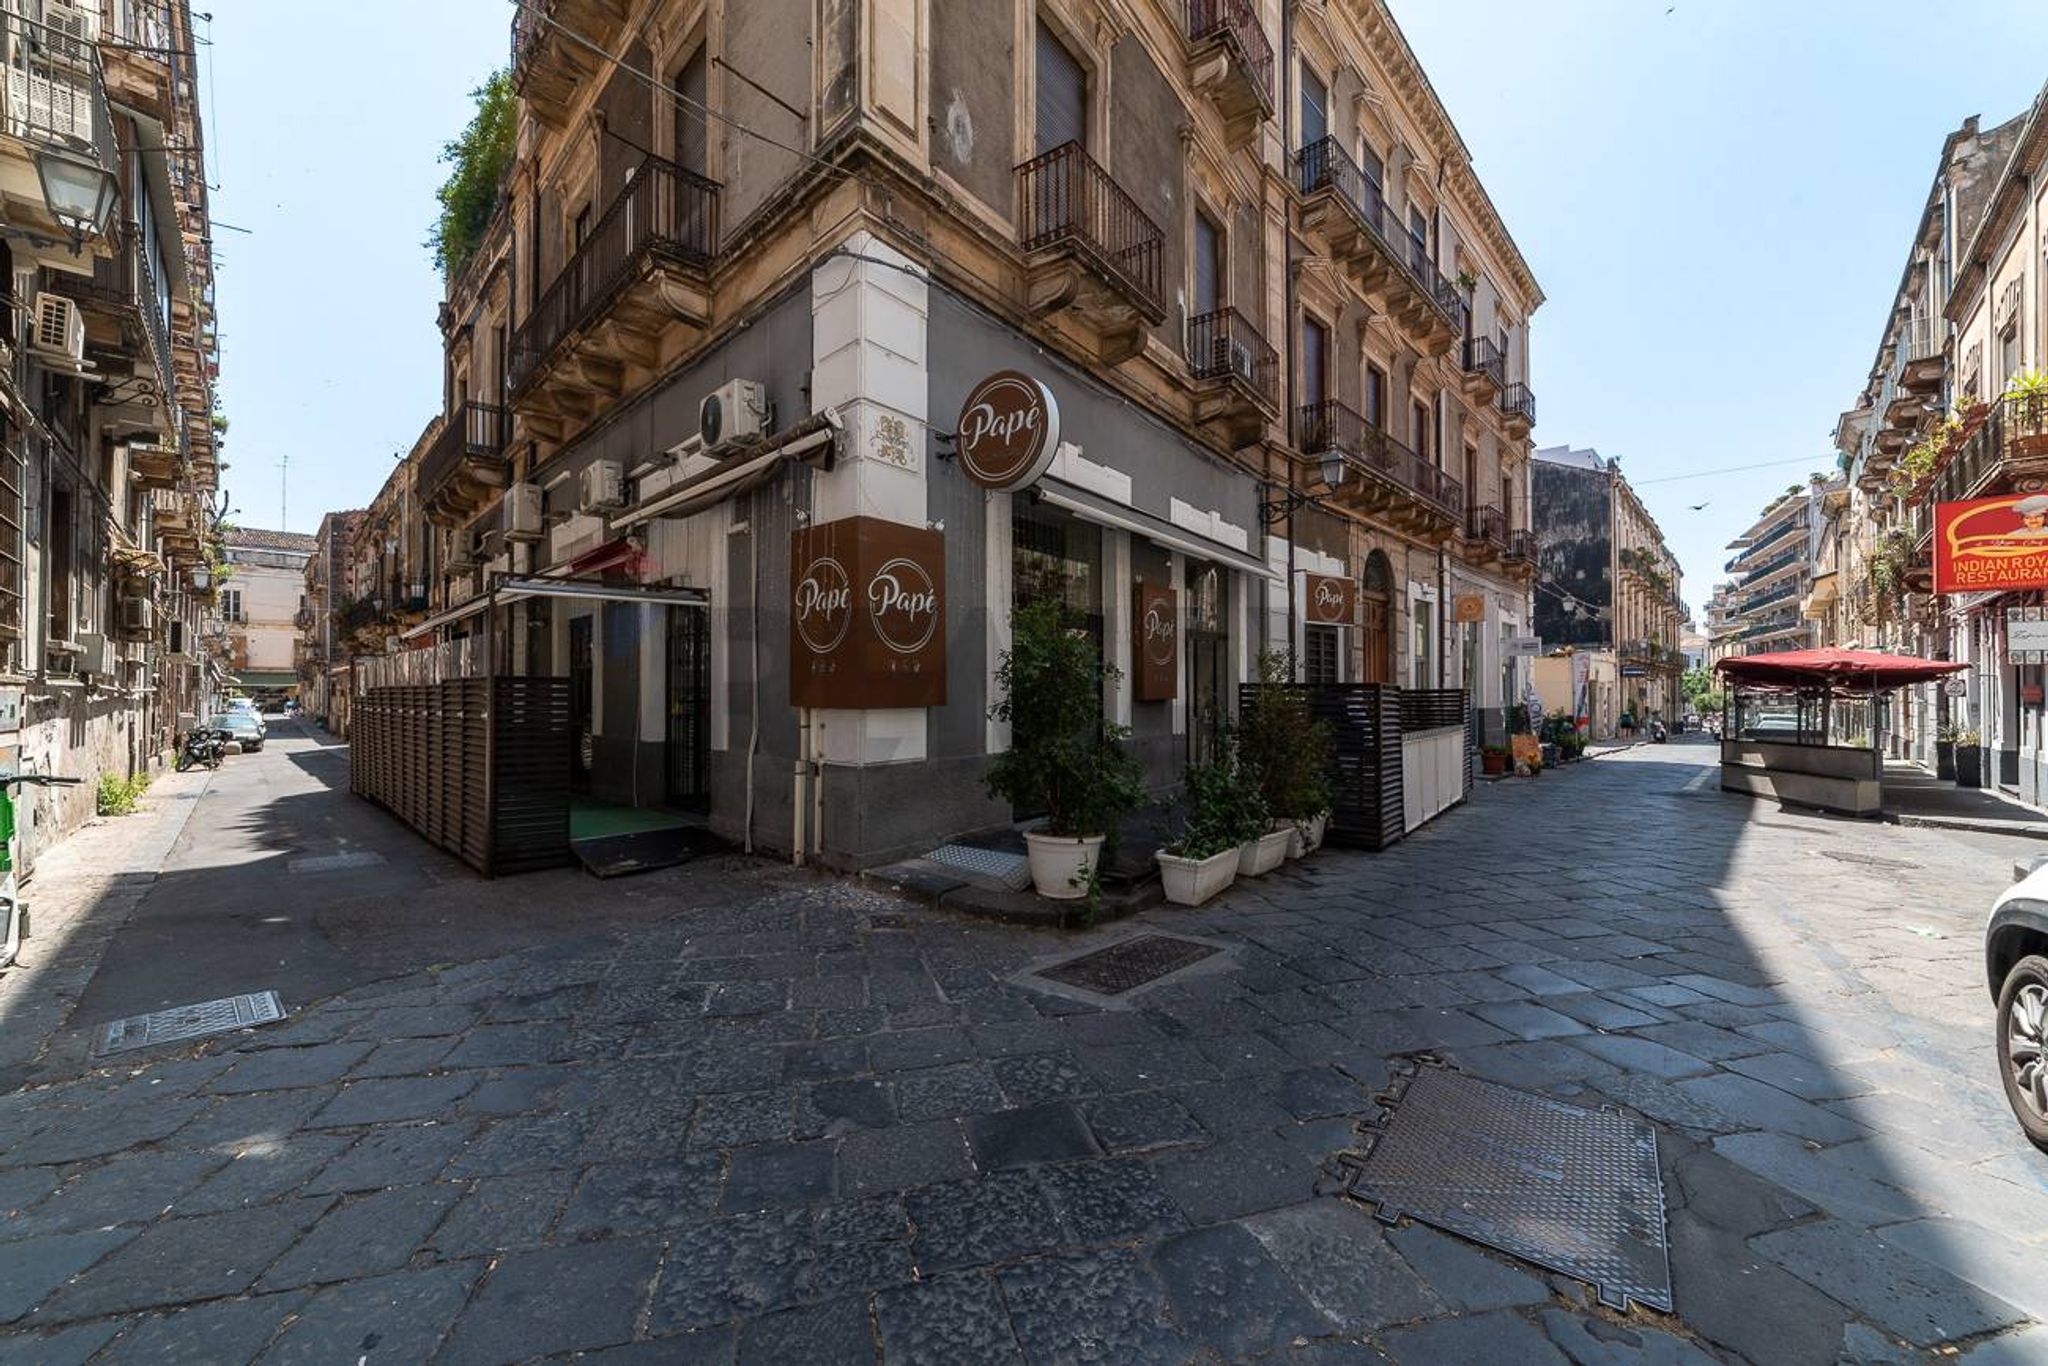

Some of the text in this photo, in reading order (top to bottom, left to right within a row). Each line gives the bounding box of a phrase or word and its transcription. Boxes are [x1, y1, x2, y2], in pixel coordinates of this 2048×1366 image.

[960, 399, 1040, 450] Papé
[1953, 554, 2048, 573] INDIAN ROY
[796, 578, 850, 621] Papé
[868, 575, 935, 622] Papé
